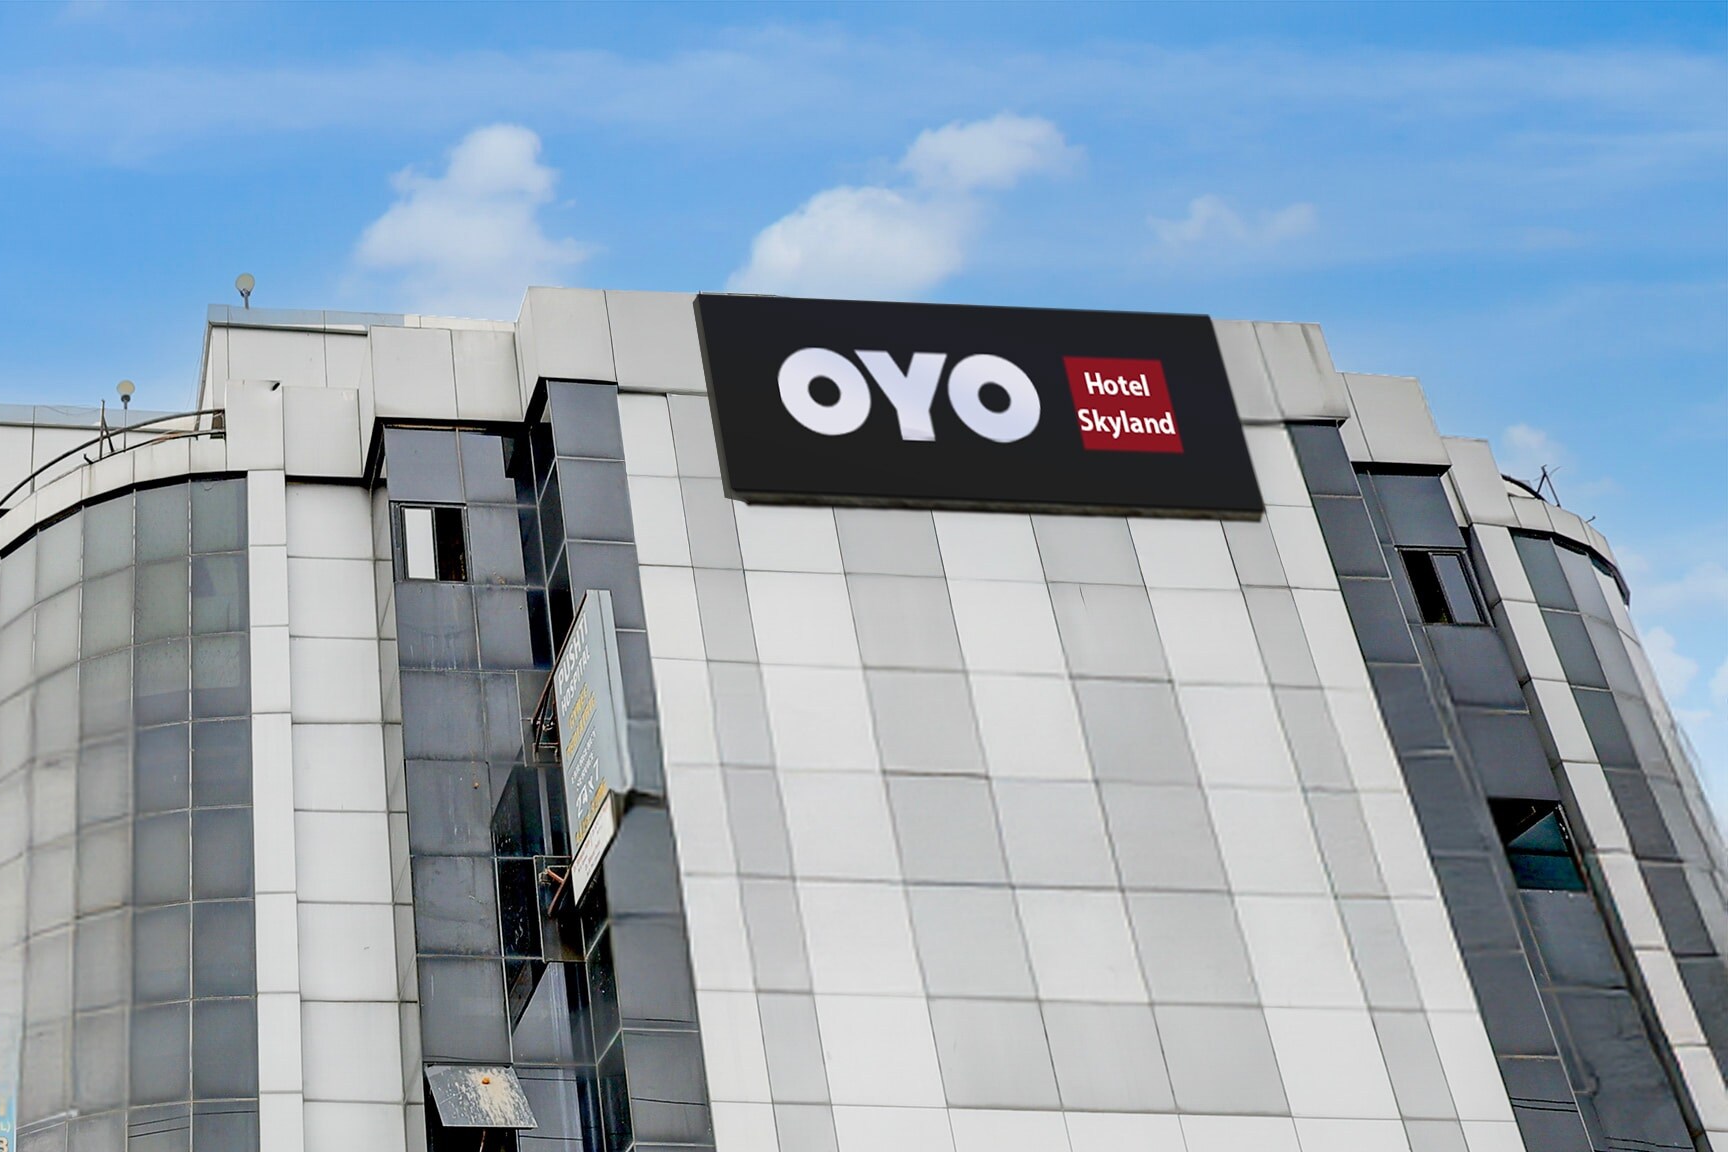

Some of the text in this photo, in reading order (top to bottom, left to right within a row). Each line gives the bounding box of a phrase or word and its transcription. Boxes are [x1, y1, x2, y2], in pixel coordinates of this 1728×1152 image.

[778, 347, 1041, 443] OYO
[1084, 371, 1150, 398] Hotel
[1077, 409, 1176, 440] Skyland
[559, 612, 588, 695] PUSHTI
[561, 644, 590, 717] HOSPITAL
